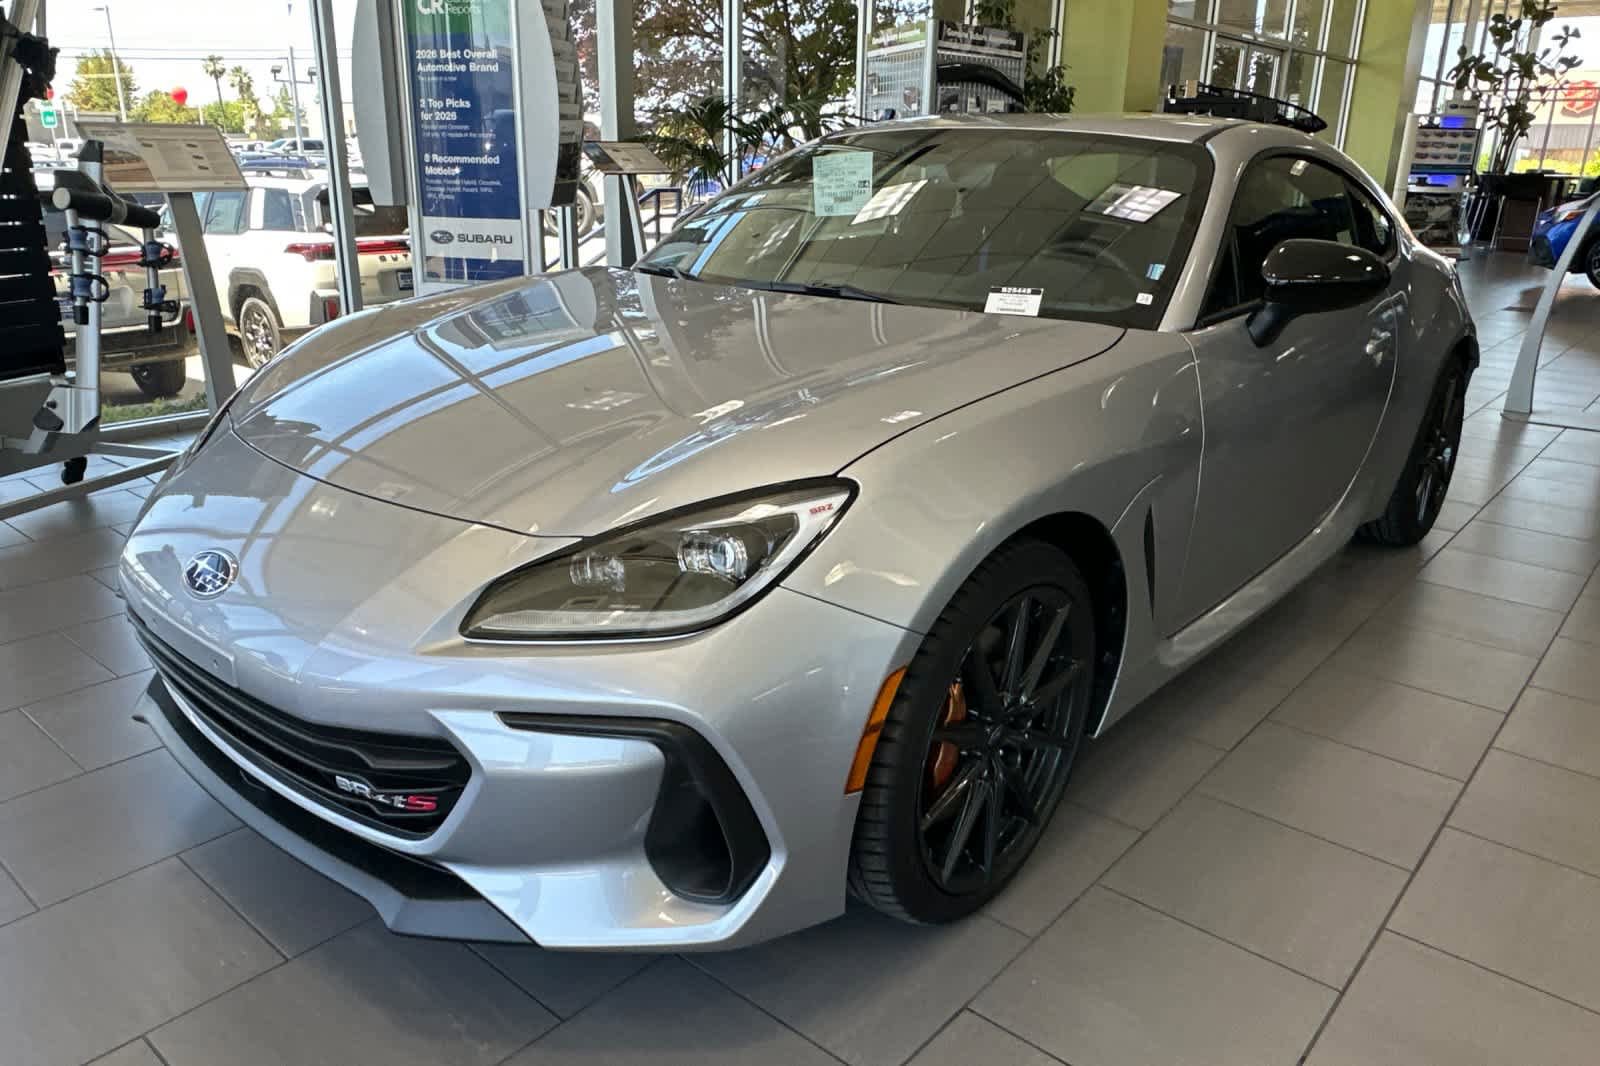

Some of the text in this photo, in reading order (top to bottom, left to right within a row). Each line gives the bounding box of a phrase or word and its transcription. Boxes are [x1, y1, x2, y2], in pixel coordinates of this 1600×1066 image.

[416, 49, 498, 60] 2026 Best Overall
[417, 62, 499, 72] Automotive Brand
[427, 98, 444, 110] Top
[446, 97, 472, 108] Picks
[420, 110, 457, 121] for 2026
[432, 154, 500, 164] Recommended
[457, 232, 513, 245] SUBARU
